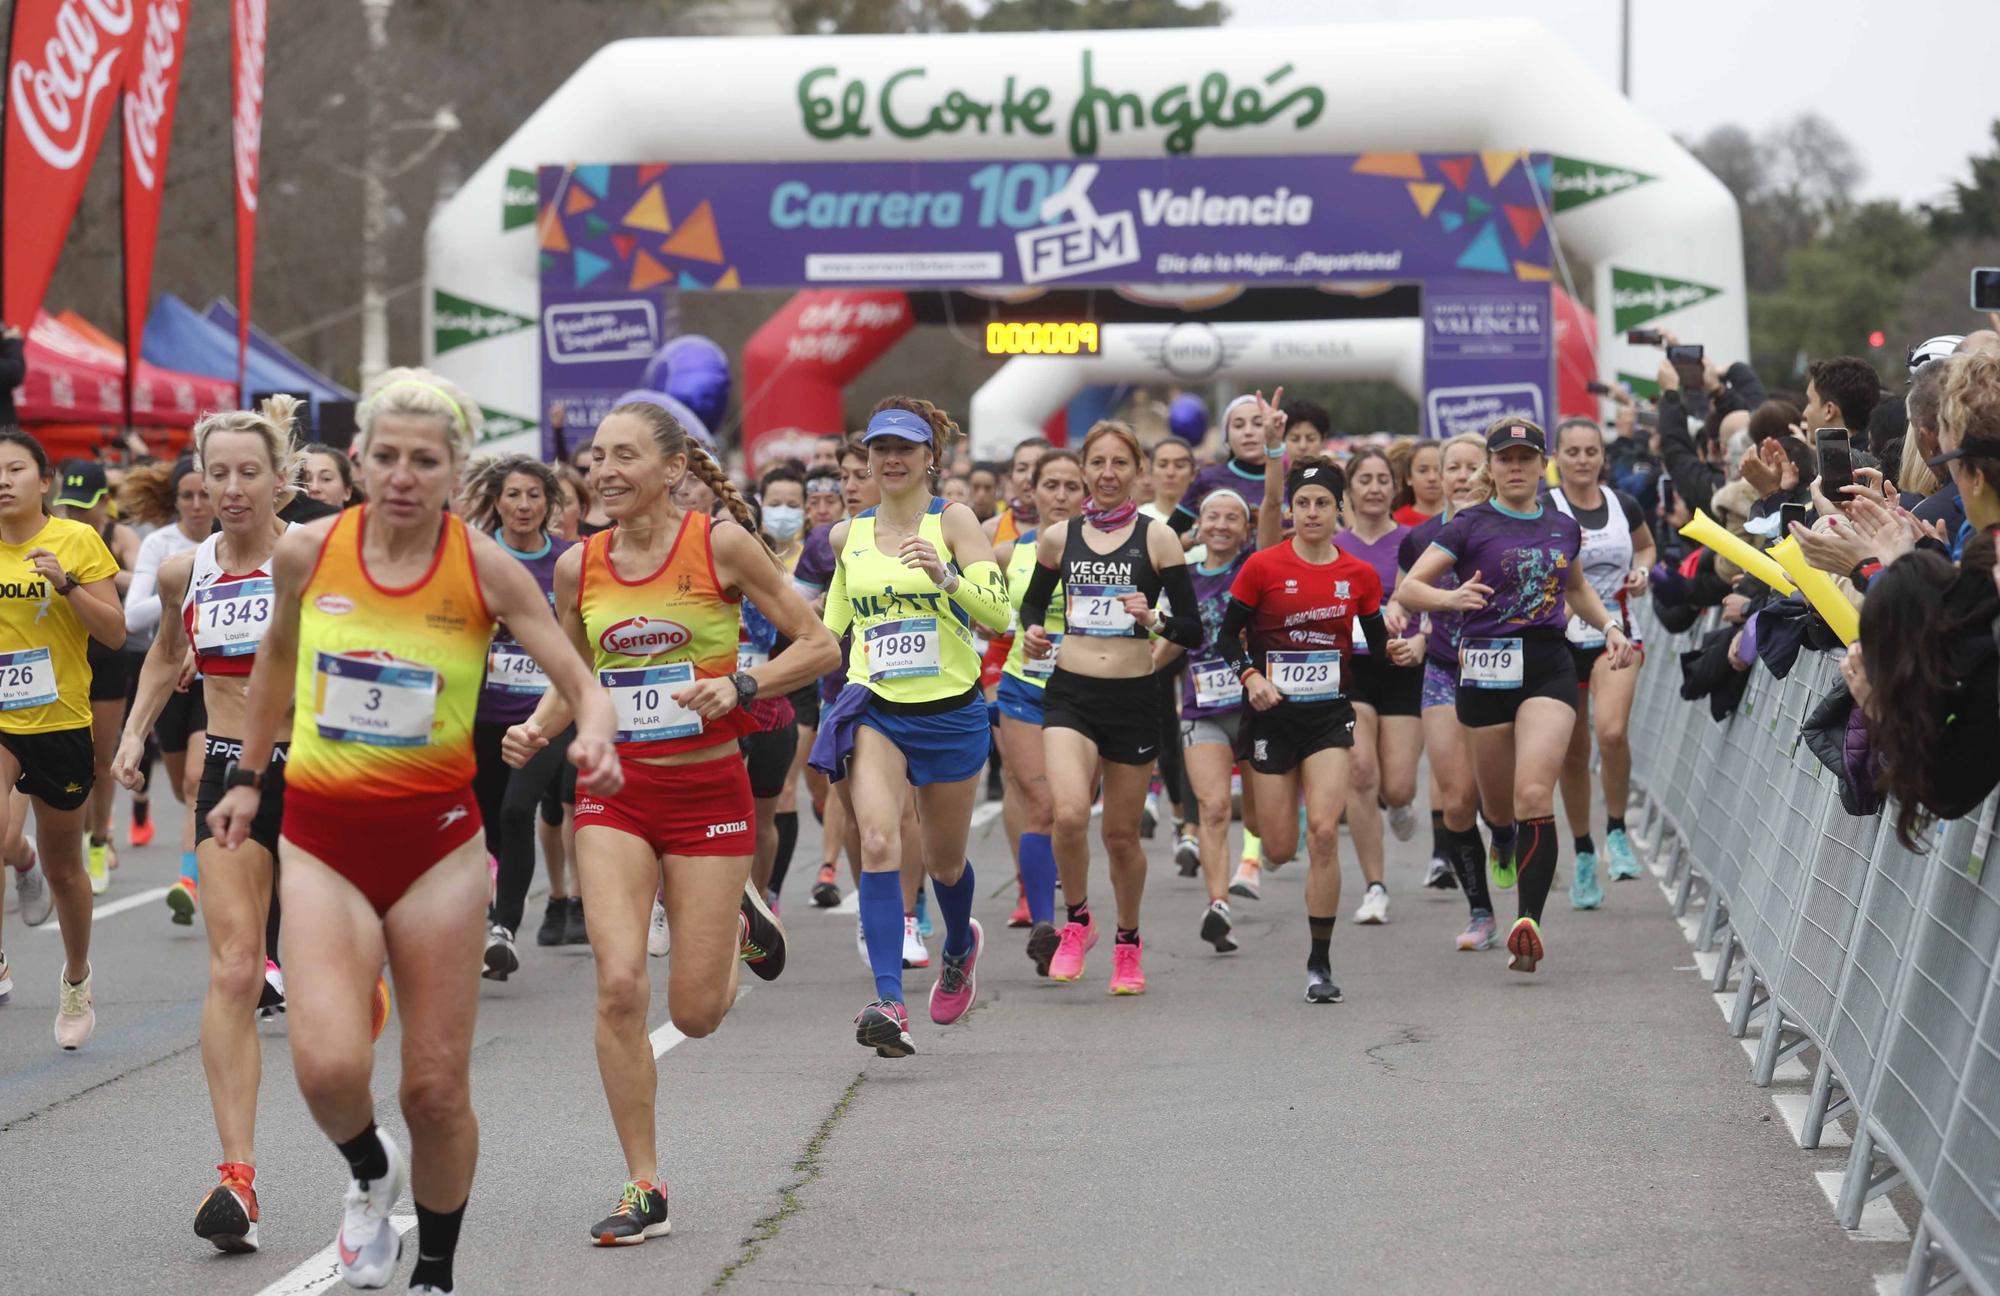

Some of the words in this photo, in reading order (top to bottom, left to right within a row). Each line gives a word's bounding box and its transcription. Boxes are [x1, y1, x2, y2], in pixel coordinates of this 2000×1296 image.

[797, 66, 871, 140] El
[880, 66, 1055, 139] Corte
[1069, 49, 1326, 157] Inglés
[769, 181, 964, 229] Carrera
[1137, 186, 1313, 227] Valencia
[1031, 217, 1128, 274] FEM
[1069, 561, 1132, 575] VEGAN
[1068, 574, 1131, 585] ATHLETES
[208, 598, 269, 628] 1343
[1089, 599, 1112, 616] 21
[608, 630, 684, 651] Serrano
[875, 634, 926, 658] 1989
[886, 659, 913, 667] Natacha
[1470, 652, 1512, 669] 1019
[1281, 665, 1329, 682] 1023
[364, 688, 382, 711] 3
[632, 689, 659, 711] 10
[633, 715, 660, 725] PILAR
